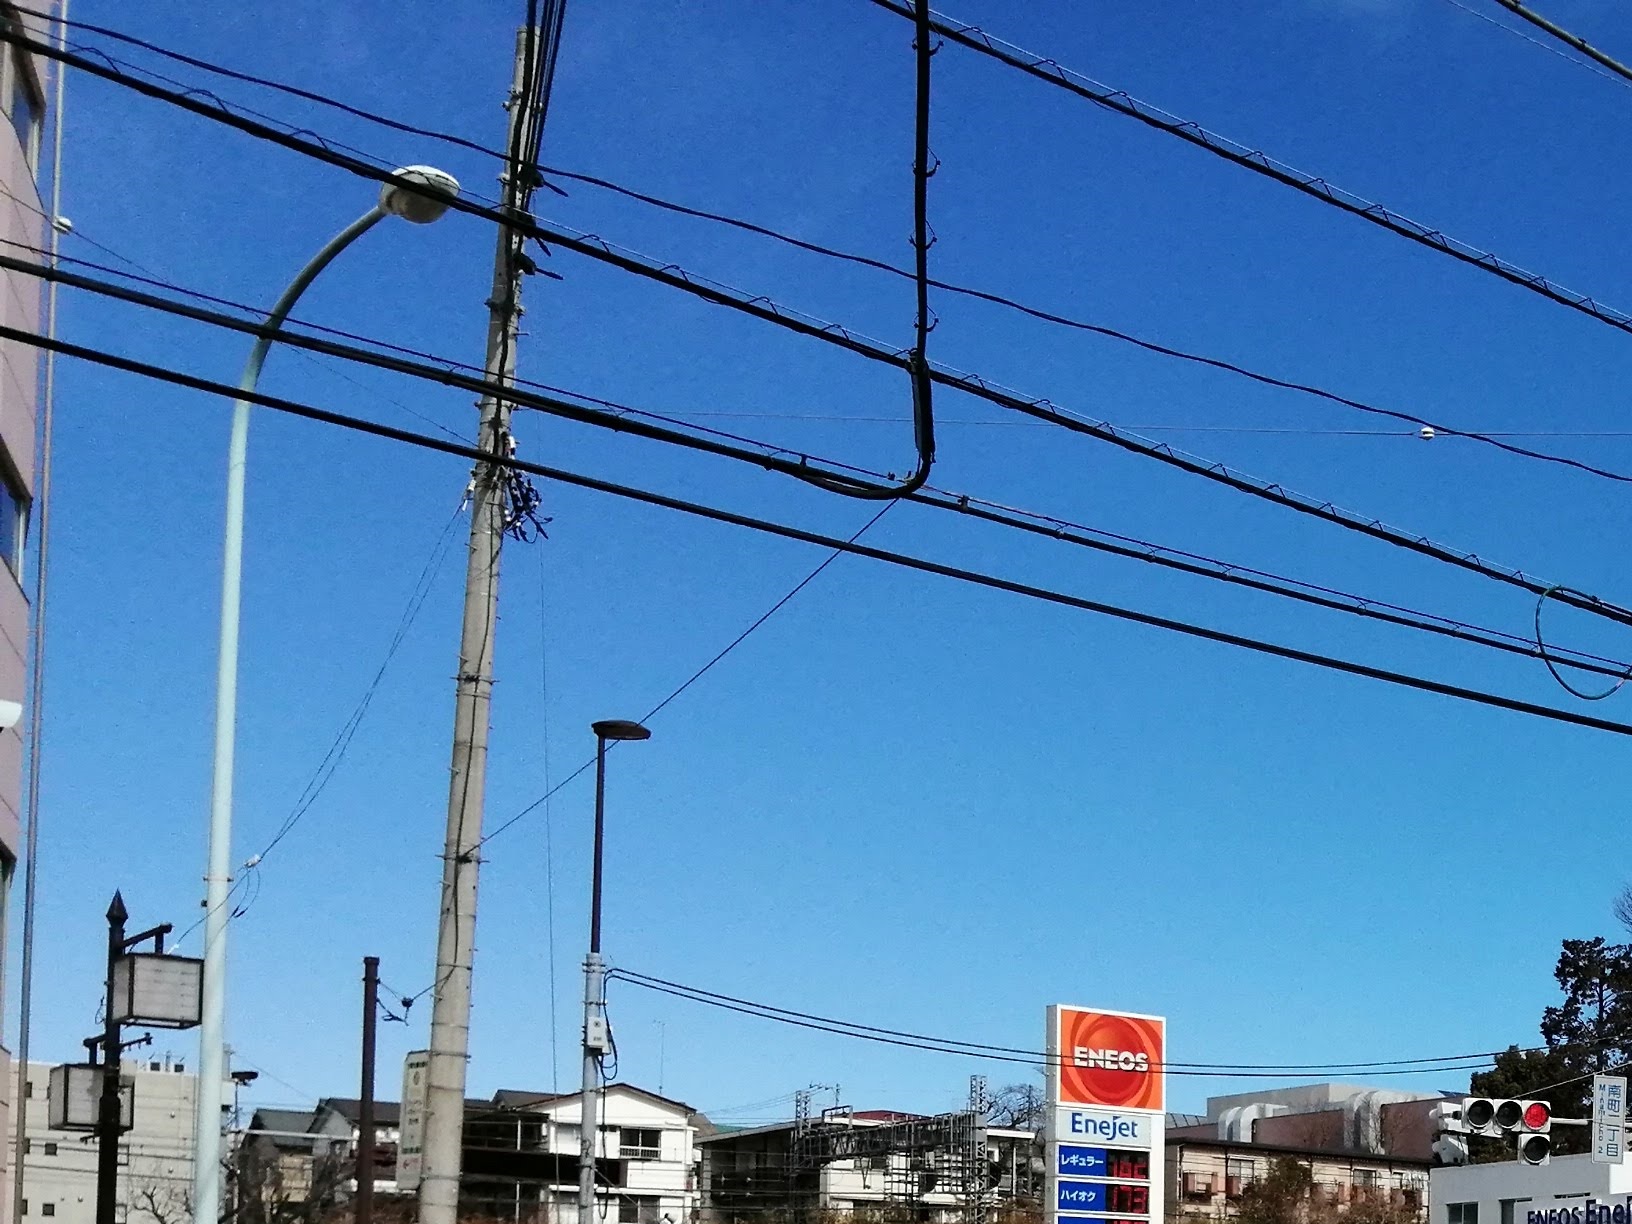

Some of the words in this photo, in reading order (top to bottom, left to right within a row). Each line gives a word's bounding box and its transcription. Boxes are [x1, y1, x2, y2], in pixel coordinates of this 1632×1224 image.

[1073, 1045, 1149, 1072] ENEOS
[1606, 1084, 1622, 1157] 南町二丁目
[1061, 1154, 1104, 1167] レギュラー
[1060, 1190, 1096, 1202] ハイオク
[1111, 1184, 1148, 1215] 173
